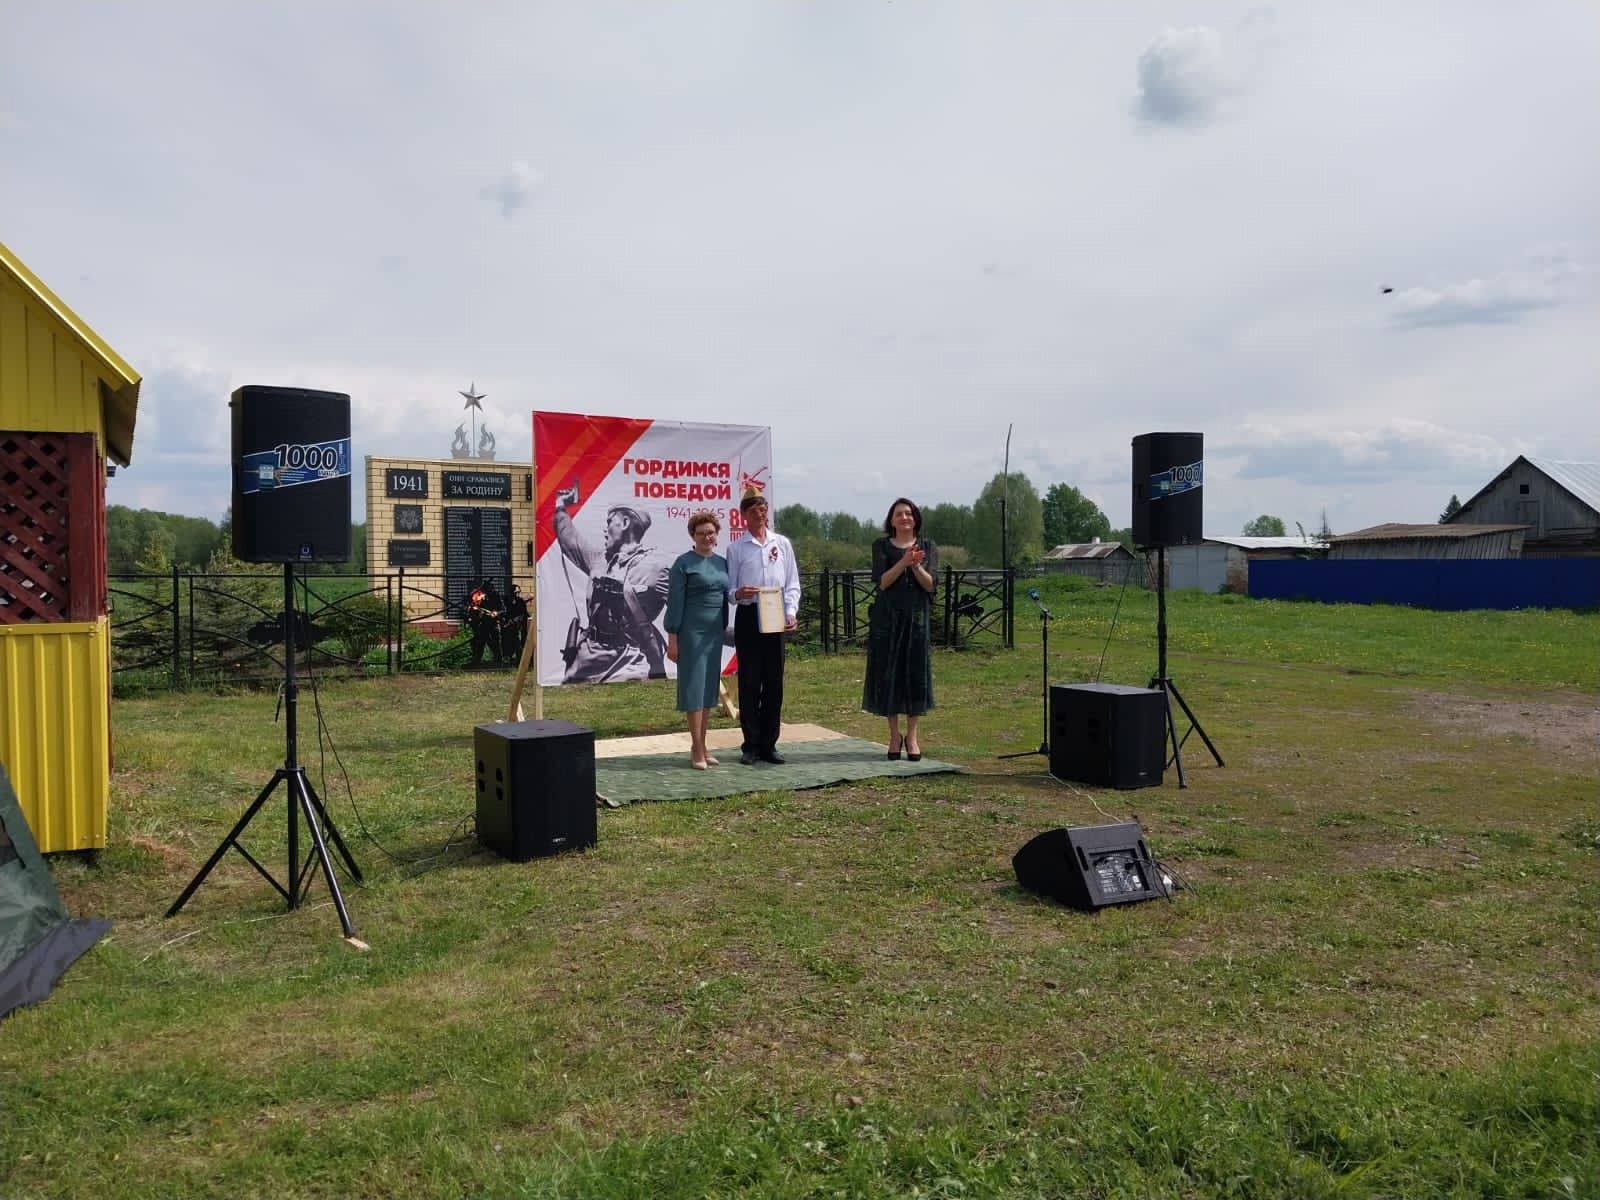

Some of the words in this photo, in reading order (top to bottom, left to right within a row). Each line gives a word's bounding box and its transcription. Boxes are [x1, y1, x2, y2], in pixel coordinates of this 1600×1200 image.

[275, 444, 338, 471] 1000
[623, 459, 731, 479] ГОРДИМСЯ
[1169, 465, 1201, 483] 1000
[392, 475, 423, 491] 1941
[451, 485, 463, 495] ЗА
[466, 486, 503, 497] РОДИНУ
[634, 480, 732, 502] ПОБЕДОЙ
